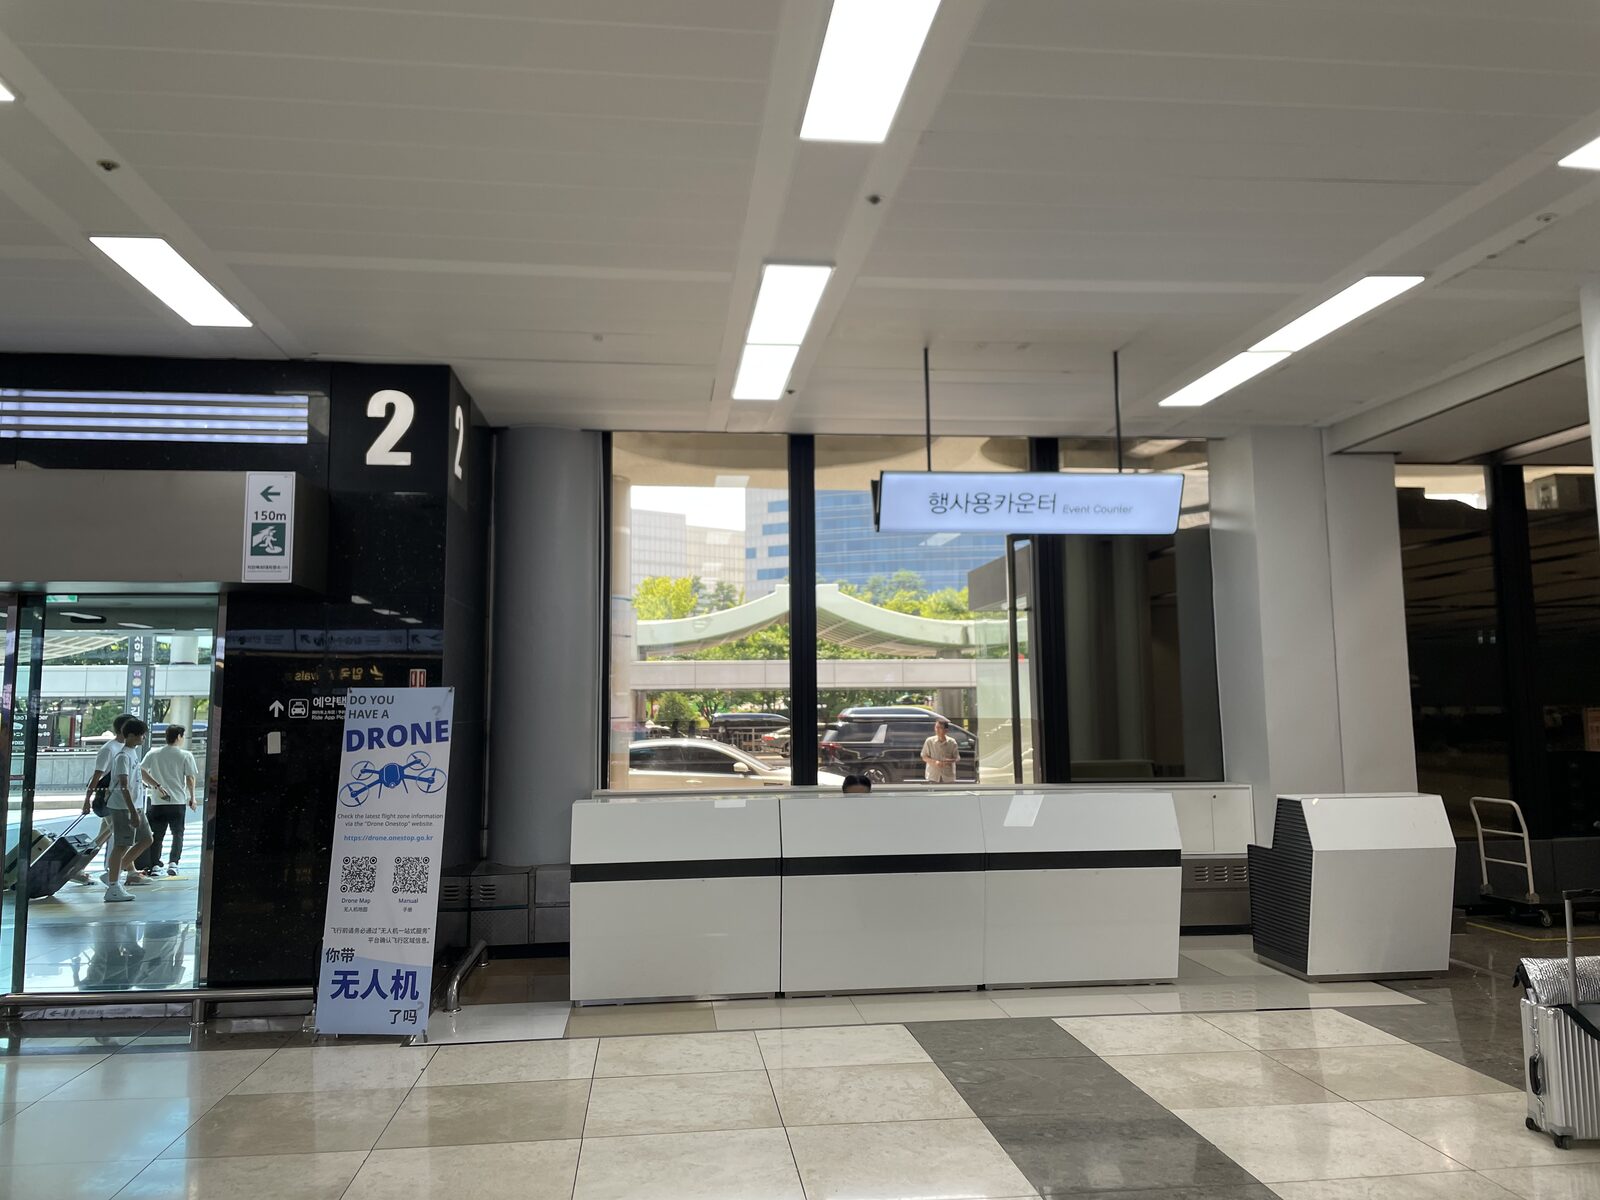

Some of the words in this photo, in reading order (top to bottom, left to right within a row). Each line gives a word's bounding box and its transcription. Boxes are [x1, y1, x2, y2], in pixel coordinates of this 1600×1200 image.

[366, 390, 414, 466] 2
[454, 405, 464, 481] 2
[928, 491, 1056, 515] 행사용카운터
[1062, 503, 1090, 514] Event
[1093, 503, 1134, 514] Counter
[254, 510, 287, 521] 150m
[349, 695, 366, 705] DO
[369, 695, 395, 705] YOU
[348, 709, 379, 719] HAVE
[380, 709, 390, 719] A
[347, 719, 449, 753] DRONE
[381, 813, 396, 821] flight
[343, 834, 433, 843] https://drone.onestop.go.kr
[341, 897, 358, 905] Drone
[358, 897, 371, 905] Map
[325, 947, 356, 964] 你带
[330, 968, 420, 1001] 无人机
[389, 1009, 418, 1025] 了吗
